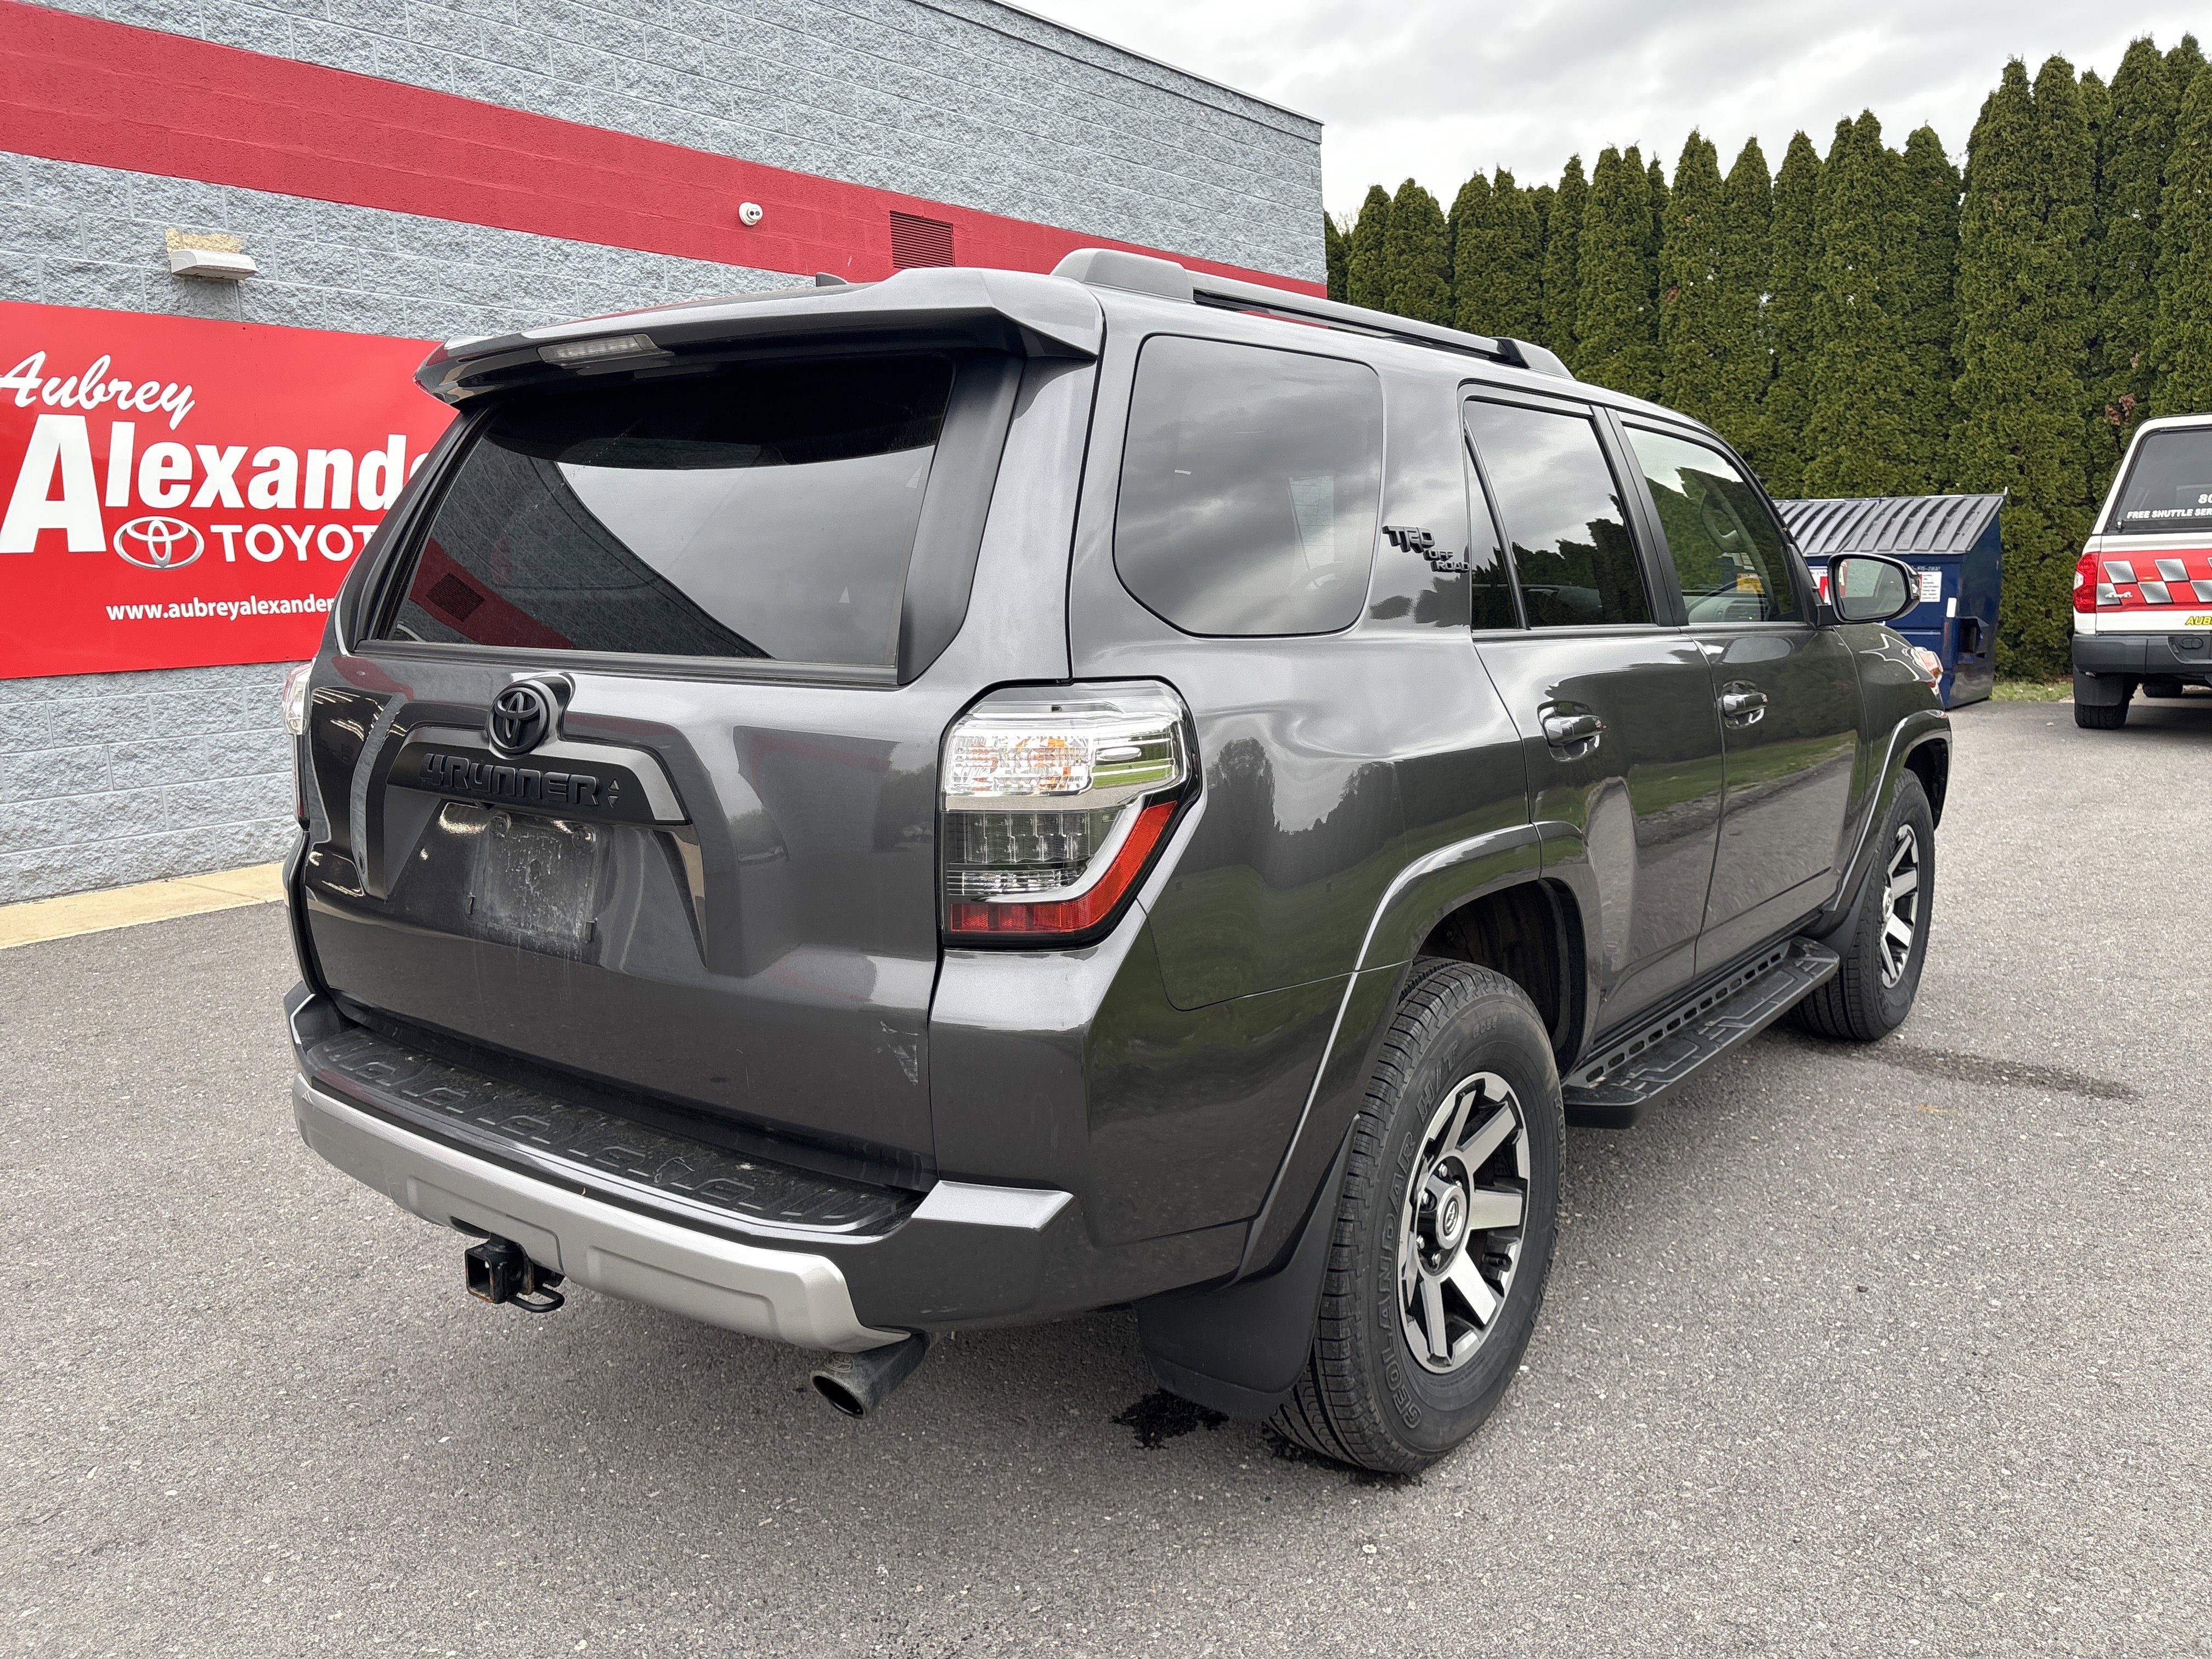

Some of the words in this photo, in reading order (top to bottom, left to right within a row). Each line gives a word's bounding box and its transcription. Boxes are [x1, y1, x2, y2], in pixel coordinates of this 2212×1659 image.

[0, 350, 195, 431] Aubrey
[2126, 510, 2151, 520] FREE
[2152, 509, 2193, 518] SHUTTLE
[1382, 525, 1435, 554] TRD
[1423, 549, 1454, 561] OFF
[1430, 560, 1470, 573] ROAD
[106, 594, 334, 622] www.aubreyalexander
[2185, 616, 2212, 625] AUB
[419, 752, 599, 806] 4RUNNER
[1377, 1130, 1424, 1429] GEOLANDAR
